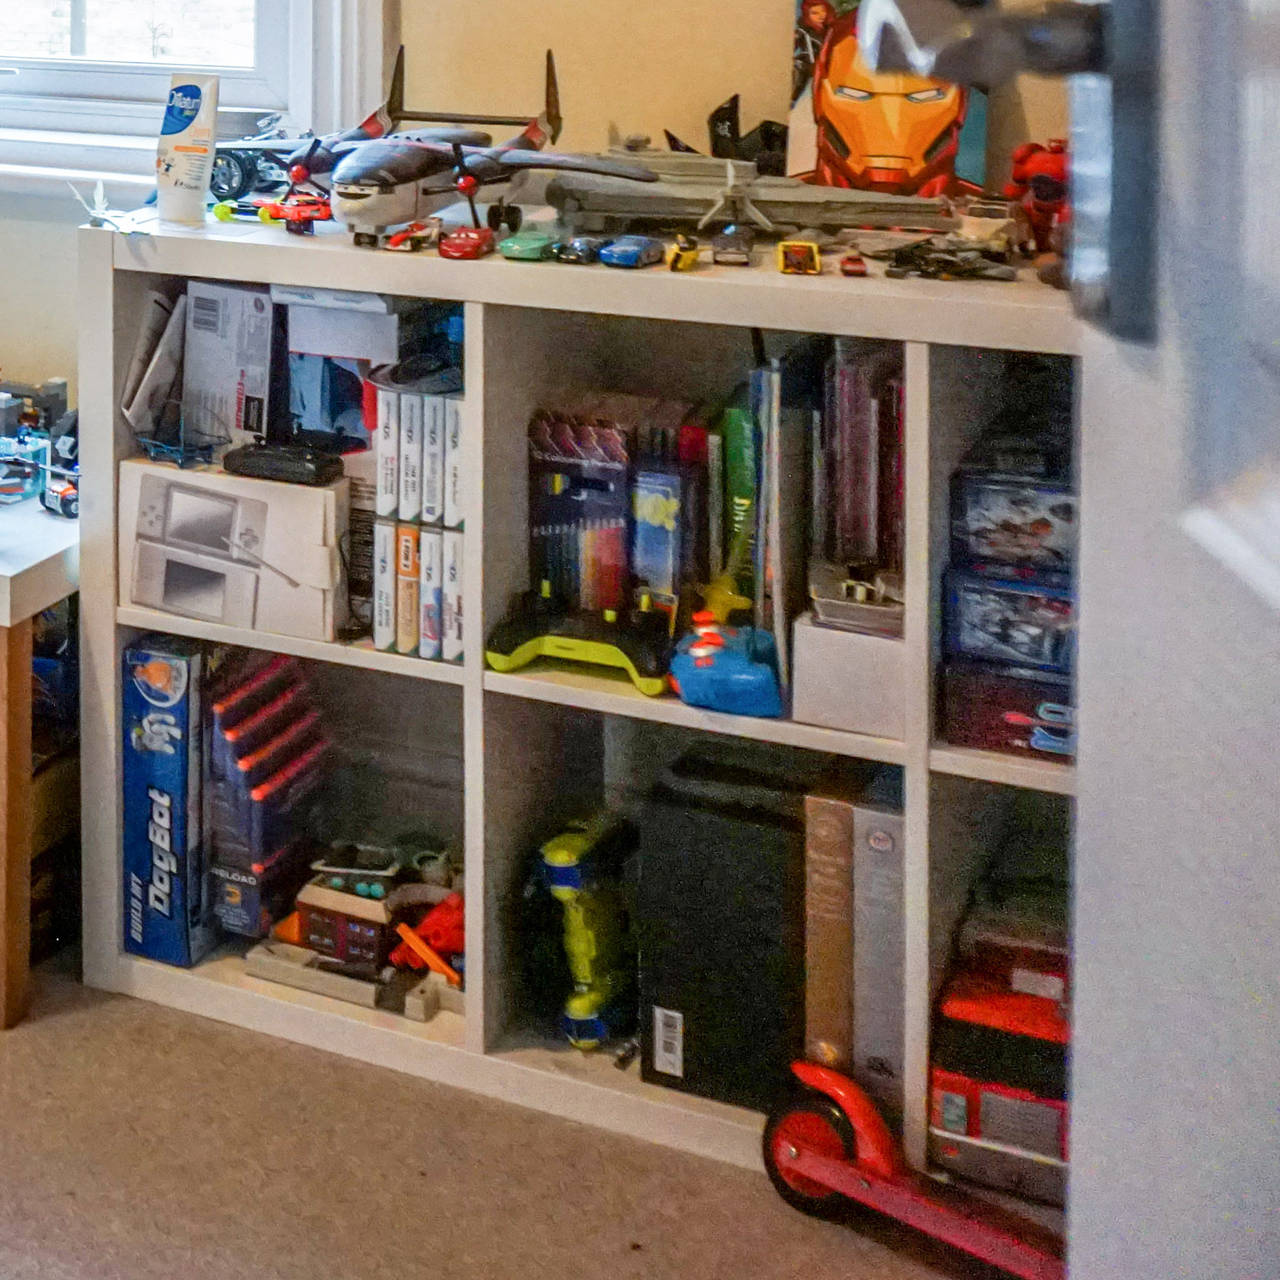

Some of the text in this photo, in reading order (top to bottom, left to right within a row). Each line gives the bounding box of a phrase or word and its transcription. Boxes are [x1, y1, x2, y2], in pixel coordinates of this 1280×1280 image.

[148, 786, 177, 917] DogBot
[130, 872, 143, 944] BUILD MY
